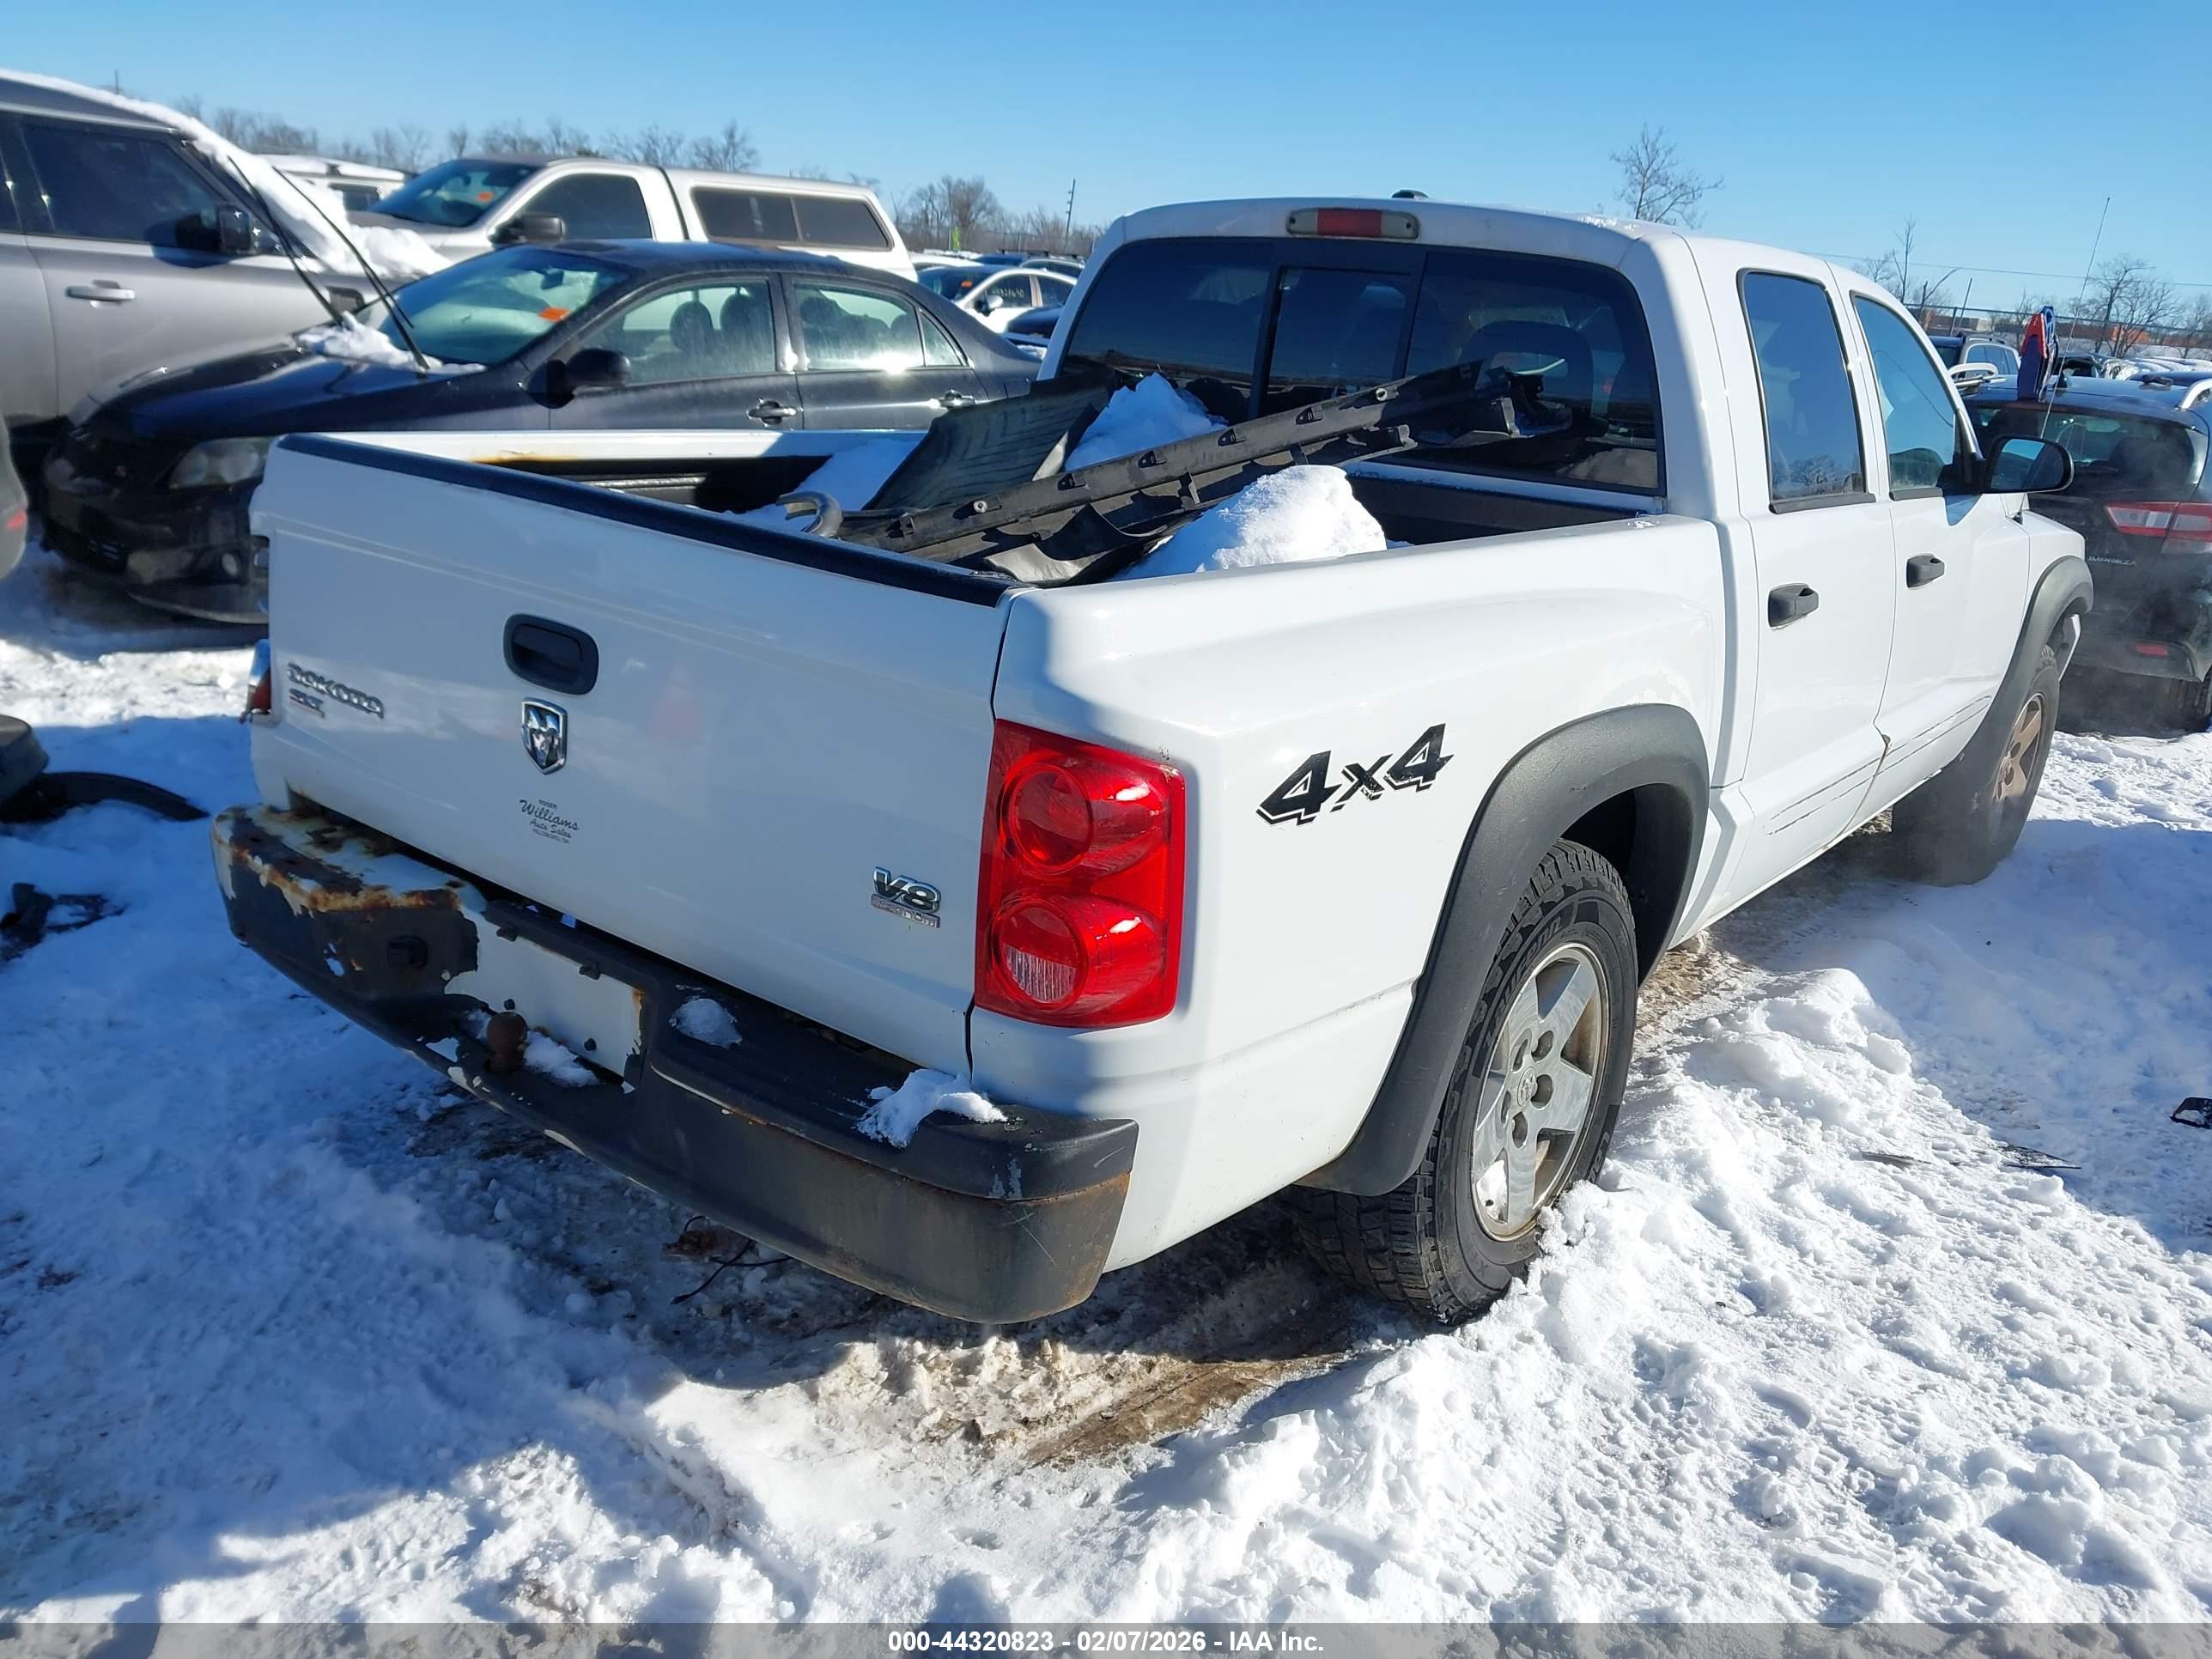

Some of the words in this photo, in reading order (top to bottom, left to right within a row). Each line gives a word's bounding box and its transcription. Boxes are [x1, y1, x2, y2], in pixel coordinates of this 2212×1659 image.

[2088, 556, 2137, 567] IMPREZA
[288, 662, 385, 720] DAKOTA
[1255, 723, 1455, 826] 4x4
[520, 799, 579, 831] Williams
[529, 818, 548, 830] Auto
[550, 824, 572, 839] Sales
[874, 866, 942, 913] V8
